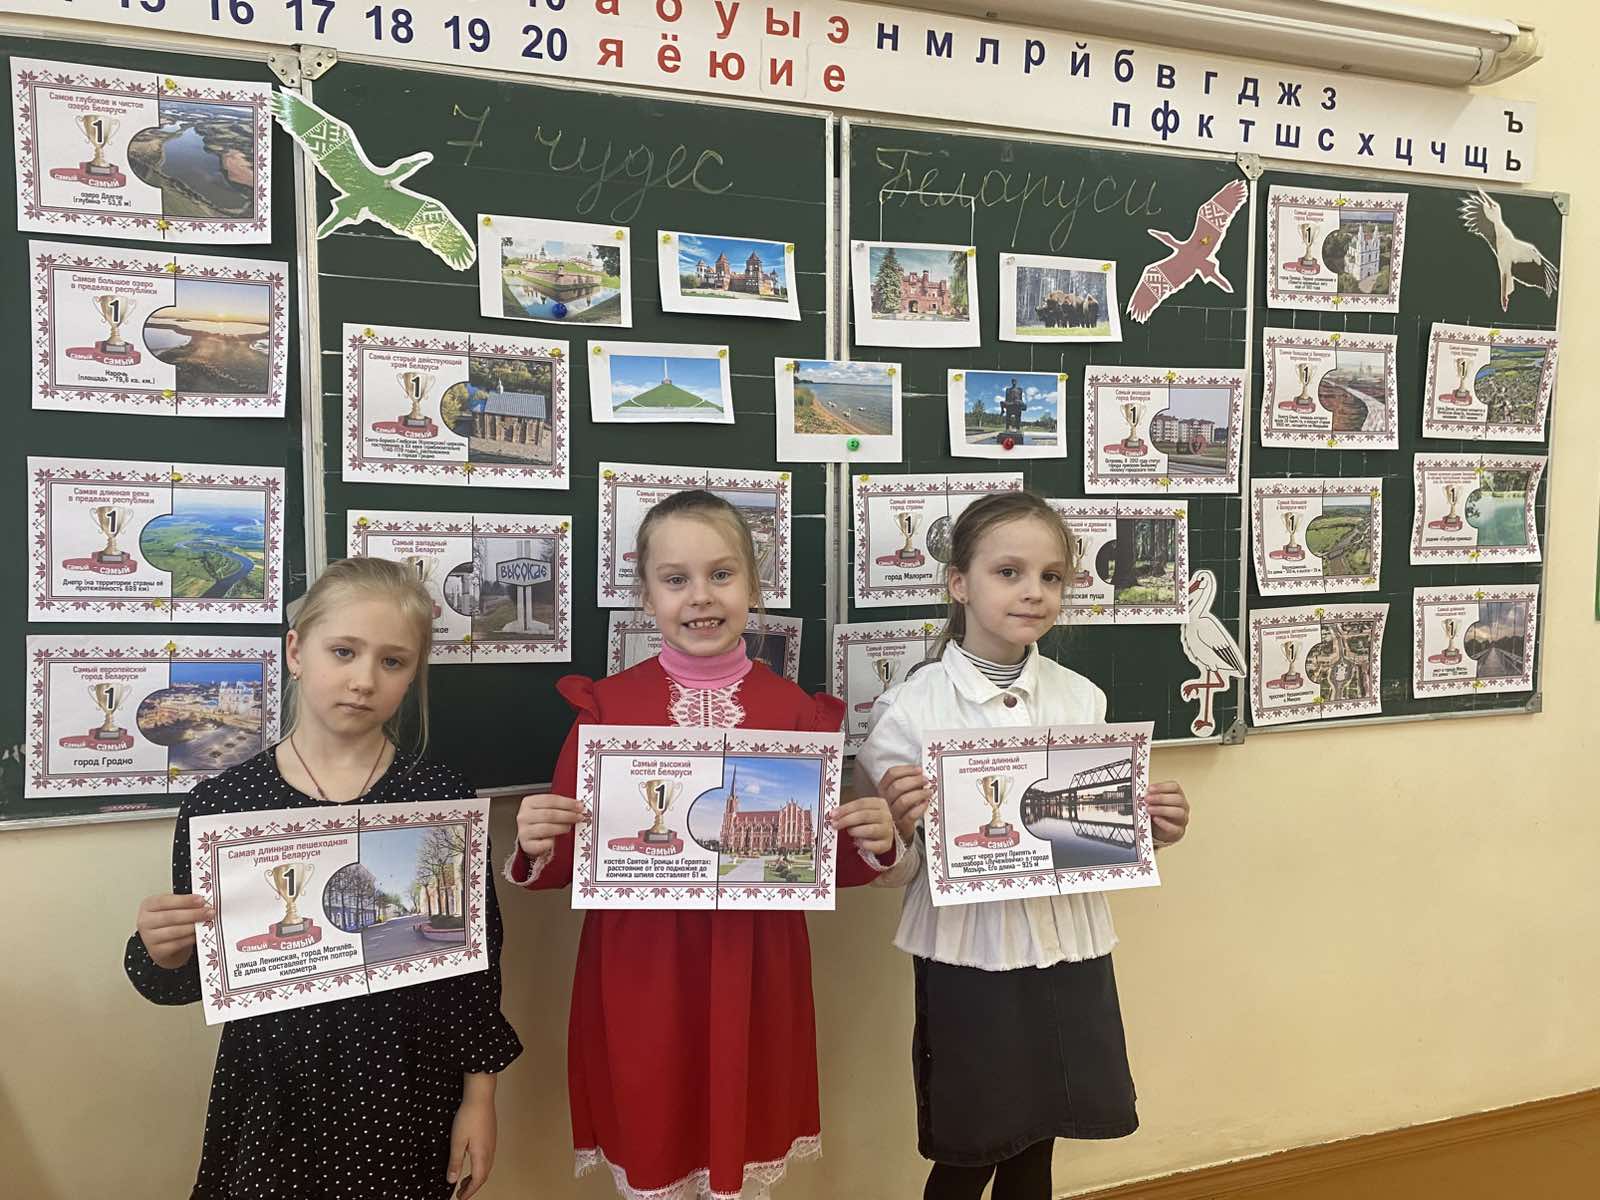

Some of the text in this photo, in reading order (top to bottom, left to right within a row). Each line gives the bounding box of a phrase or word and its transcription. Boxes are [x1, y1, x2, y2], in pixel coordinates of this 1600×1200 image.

[286, 0, 336, 34] 17
[365, 5, 414, 44] 18
[444, 15, 491, 53] 19
[521, 24, 568, 62] 20
[715, 0, 740, 40] у
[765, 7, 800, 39] ы
[827, 15, 850, 45] э
[876, 22, 899, 51] н
[926, 29, 953, 59] м
[975, 37, 1000, 65] л
[1024, 39, 1046, 74] р
[1070, 41, 1090, 78] й
[1114, 49, 1135, 83] б
[1157, 63, 1176, 90] в
[1203, 71, 1218, 95] г
[1238, 76, 1260, 107] д
[1277, 82, 1302, 107] ж
[1320, 87, 1337, 111] з
[1503, 110, 1524, 133] ъ
[49, 92, 74, 102] Самое
[75, 95, 110, 106] глубокое
[118, 101, 144, 109] чистое
[597, 33, 1522, 174] я ё ю и е п ф к т ш с х ц ч щ ь
[68, 103, 127, 115] озеро Беларуси
[93, 120, 103, 143] 1
[447, 104, 734, 224] 7 чудес
[875, 146, 1162, 252] Беларуси
[1306, 227, 1311, 243] 1
[78, 284, 113, 293] пределах
[115, 285, 158, 296] республики
[98, 276, 131, 287] большое
[132, 281, 154, 289] озеро
[110, 300, 120, 323] 1
[104, 357, 134, 366] самый
[409, 362, 440, 372] Беларуси
[1461, 360, 1466, 377] 1
[1304, 366, 1309, 382] 1
[412, 377, 420, 398] 1
[1131, 406, 1136, 424] 1
[74, 488, 98, 496] Самая
[100, 490, 131, 498] длинная
[75, 496, 110, 504] пределах
[113, 496, 155, 506] республики
[636, 489, 656, 497] Самый
[107, 511, 116, 533] 1
[904, 516, 913, 534] 1
[1290, 515, 1295, 531] 1
[415, 546, 445, 555] Беларуси
[1077, 538, 1083, 555] 1
[416, 560, 424, 581] 1
[884, 572, 933, 582] город Малорита
[1449, 621, 1454, 636] 1
[1290, 644, 1294, 660] 1
[81, 672, 139, 682] город Беларуси
[100, 666, 147, 675] европейский
[883, 662, 890, 680] 1
[105, 687, 115, 709] 1
[96, 742, 127, 752] самый
[74, 757, 133, 769] город Гродно
[632, 759, 692, 768] Самый высокий
[959, 765, 1011, 774] автомобильного
[968, 757, 1020, 766] Самый длинный
[630, 767, 693, 778] костёл Беларуси
[655, 784, 665, 809] 1
[991, 780, 999, 803] 1
[228, 838, 348, 860] Самая длинная пешеходная
[645, 846, 677, 856] самый
[987, 838, 1014, 849] самый
[253, 849, 321, 867] улица Беларуси
[999, 863, 1016, 871] длина
[283, 868, 295, 896] 1
[280, 935, 315, 950] самый
[235, 958, 258, 970] улица
[259, 952, 300, 966] Ленинская,
[301, 949, 322, 959] город
[244, 965, 267, 977] длина
[268, 959, 307, 972] составляет
[308, 954, 330, 964] почти
[330, 949, 358, 961] полтора
[280, 964, 317, 977] километра
